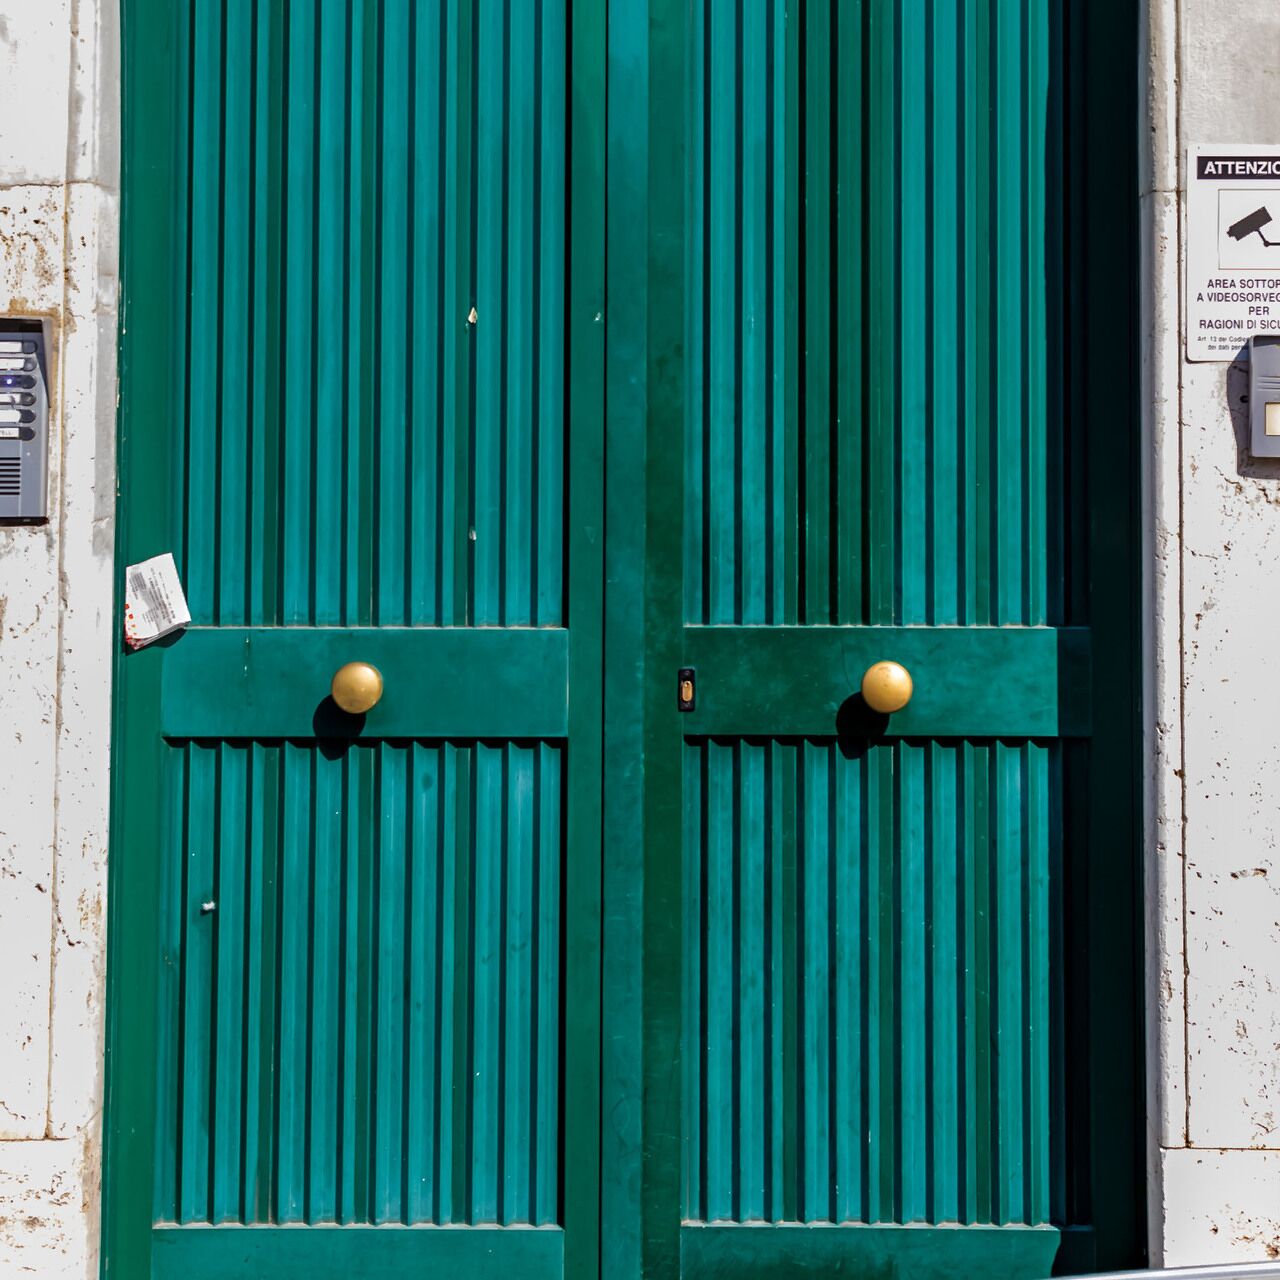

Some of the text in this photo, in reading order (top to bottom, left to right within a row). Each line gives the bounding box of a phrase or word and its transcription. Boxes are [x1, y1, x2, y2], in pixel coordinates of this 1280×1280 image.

[1207, 279, 1236, 289] AREA
[1196, 293, 1204, 302] A
[1248, 306, 1270, 316] PER
[1199, 319, 1244, 330] RAGIONI
[1247, 320, 1257, 329] DI
